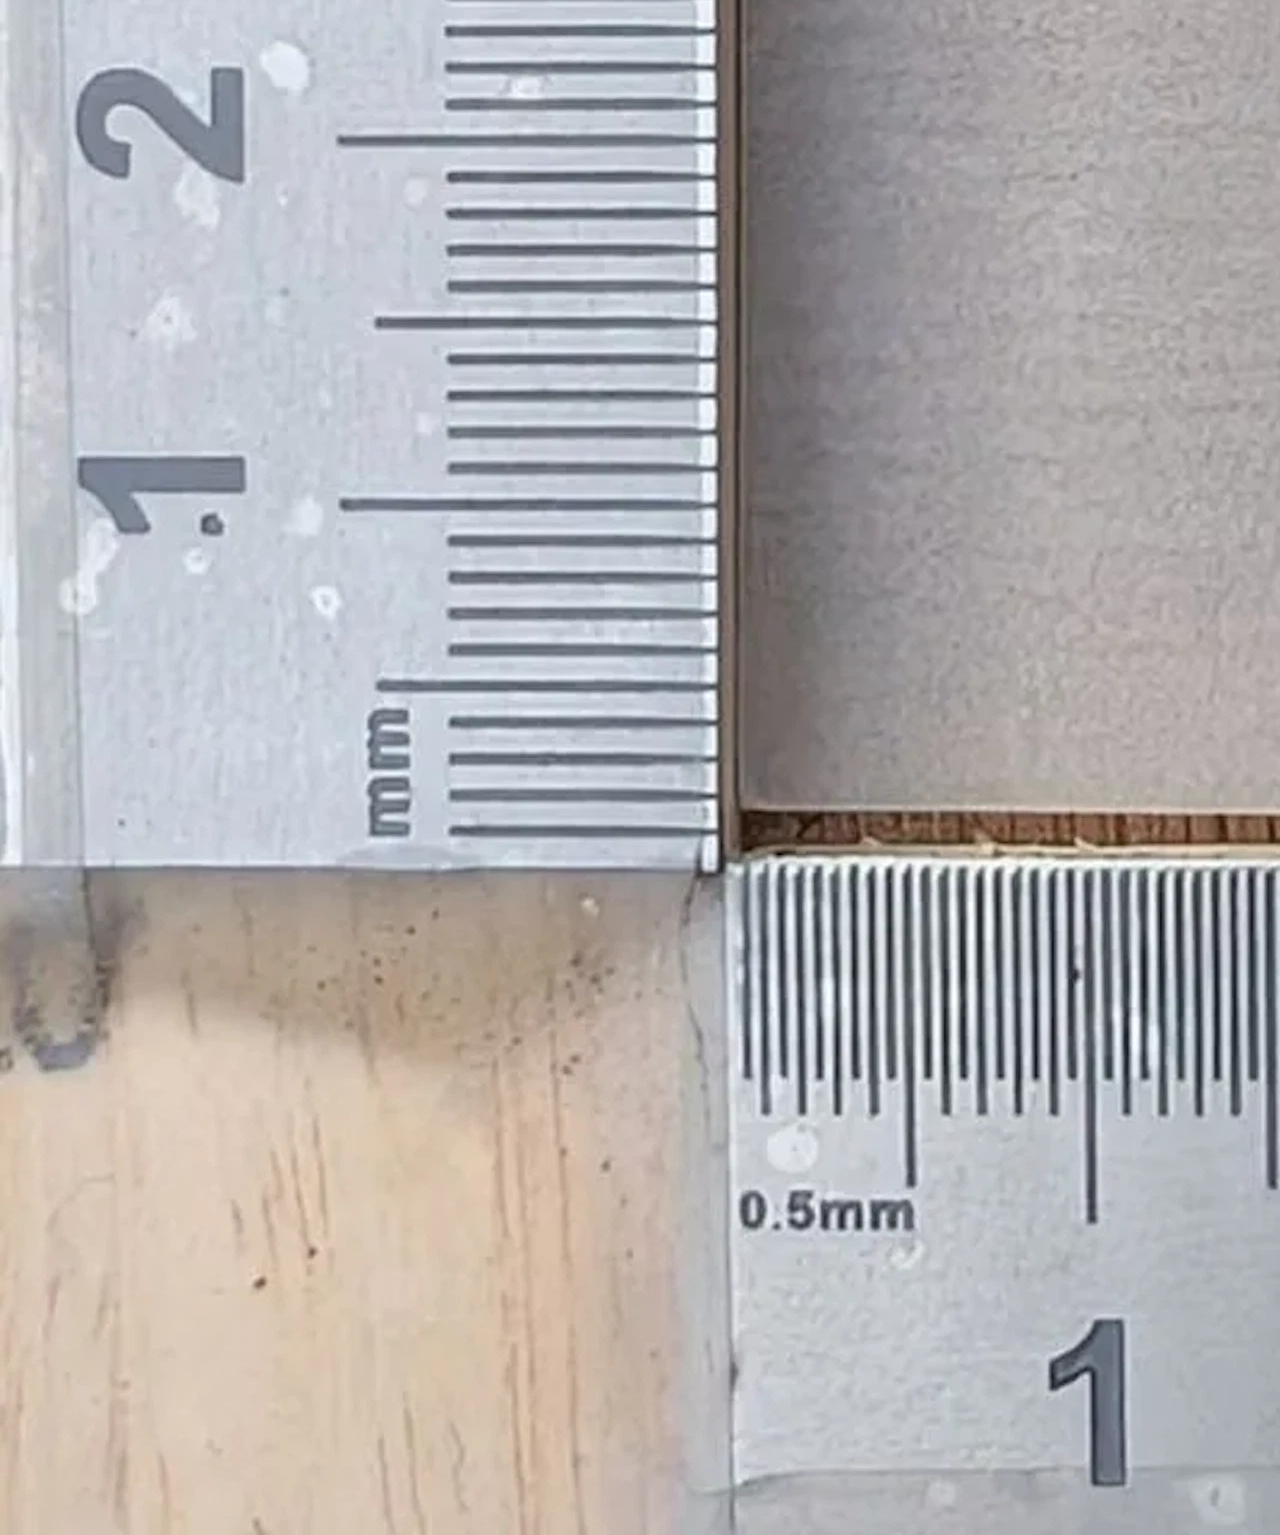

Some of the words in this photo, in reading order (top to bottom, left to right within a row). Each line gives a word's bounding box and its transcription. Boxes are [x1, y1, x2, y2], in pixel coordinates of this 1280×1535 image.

[75, 66, 245, 183] 2
[367, 706, 412, 838] mm
[738, 1187, 915, 1235] 0.5mm
[1048, 1318, 1127, 1486] 1
